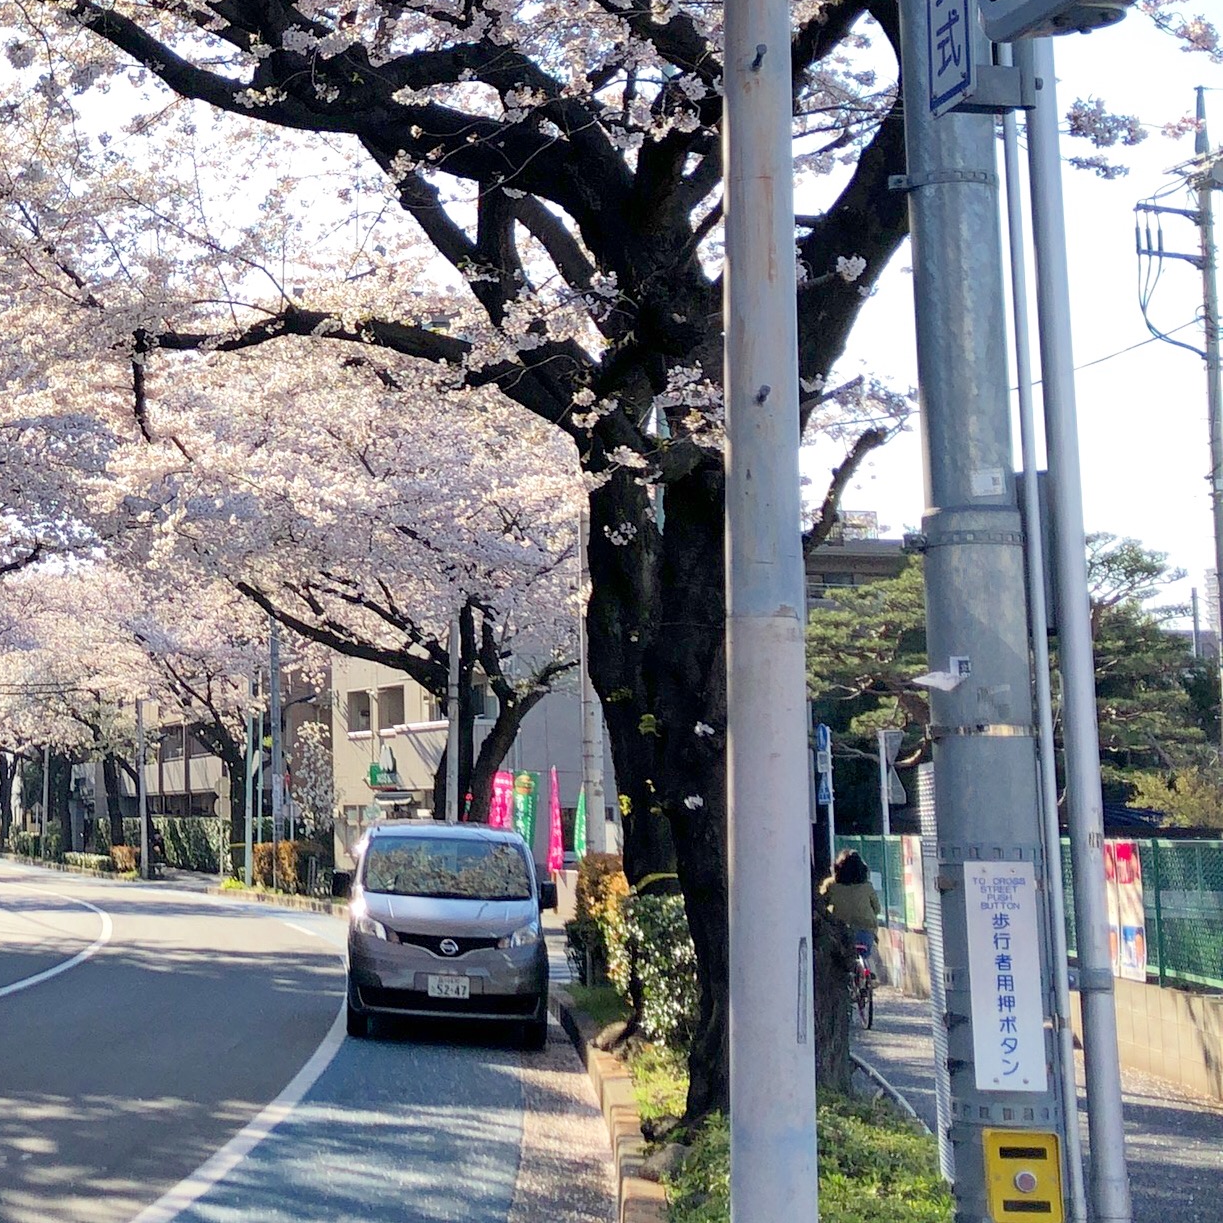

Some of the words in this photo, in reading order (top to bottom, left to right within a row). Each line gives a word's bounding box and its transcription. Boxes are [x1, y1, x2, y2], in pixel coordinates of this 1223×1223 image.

[973, 877, 986, 885] TO
[992, 877, 1026, 886] CROSS
[980, 886, 1017, 894] STREET
[980, 902, 1021, 910] BUTTON
[992, 912, 1019, 1076] 歩行者用押ボタン
